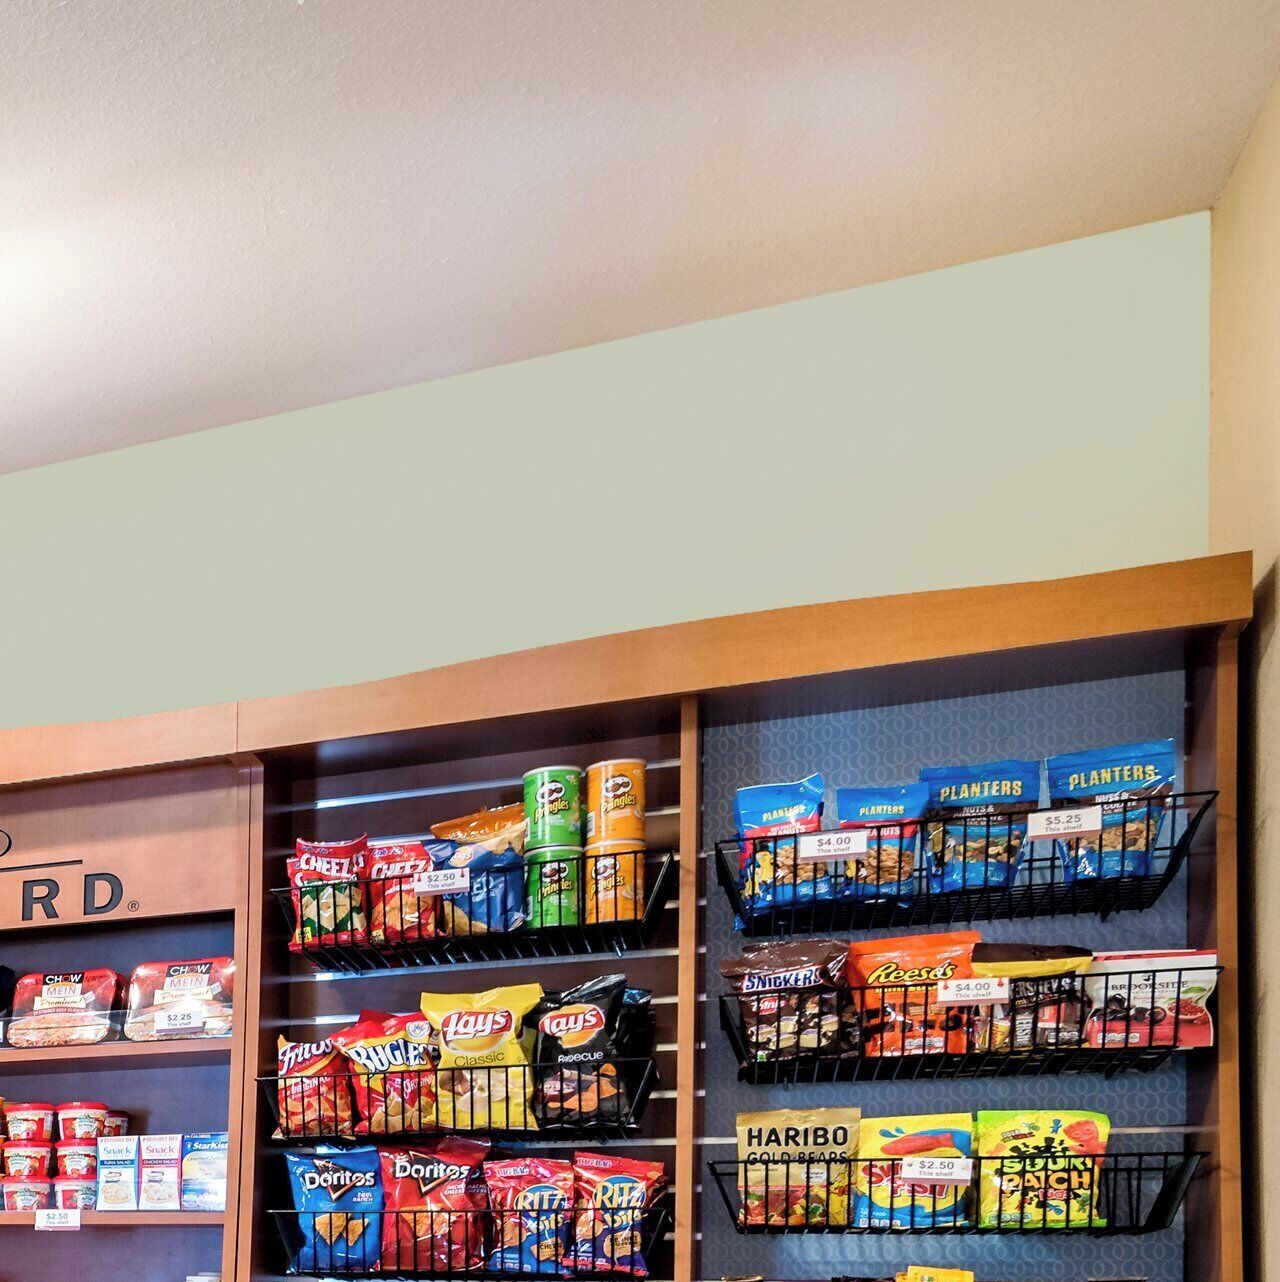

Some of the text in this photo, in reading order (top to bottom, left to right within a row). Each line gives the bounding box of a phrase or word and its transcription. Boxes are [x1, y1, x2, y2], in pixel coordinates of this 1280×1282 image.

[1069, 764, 1156, 791] PLANTERS
[941, 781, 1022, 802] PLANTERS
[534, 799, 570, 822] Pringles
[601, 794, 637, 814] Pringles
[859, 805, 904, 816] PLANTERS
[1045, 814, 1082, 825] $5.25
[817, 837, 851, 847] $4.00
[427, 873, 456, 882] $2.50
[537, 874, 572, 895] Pringles
[590, 872, 625, 898] Pringles
[170, 964, 209, 975] CHOW
[45, 974, 82, 984] CHOW
[170, 978, 203, 988] MEIN
[745, 966, 823, 991] SNICKERS
[46, 986, 76, 996] MEIN
[955, 982, 991, 991] $4.00
[1111, 981, 1189, 990] BROOKSIDE
[38, 997, 85, 1007] Premium!
[162, 990, 210, 1001] Premium!
[167, 1013, 191, 1022] $2.25
[444, 1010, 512, 1042] Lay's
[279, 1039, 333, 1076] Fritos
[347, 1039, 428, 1072] BUGLES
[454, 1051, 505, 1067] Classic
[747, 1126, 848, 1147] HARIBO
[103, 1146, 131, 1155] Snack
[145, 1146, 174, 1155] Snack
[395, 1160, 471, 1179] Doritos
[919, 1161, 954, 1171] $2.50
[305, 1169, 375, 1190] Doritos
[1002, 1173, 1090, 1190] PATCH
[520, 1190, 566, 1210] RITZ
[595, 1182, 646, 1208] RITZ
[46, 1212, 69, 1220] $2.50
